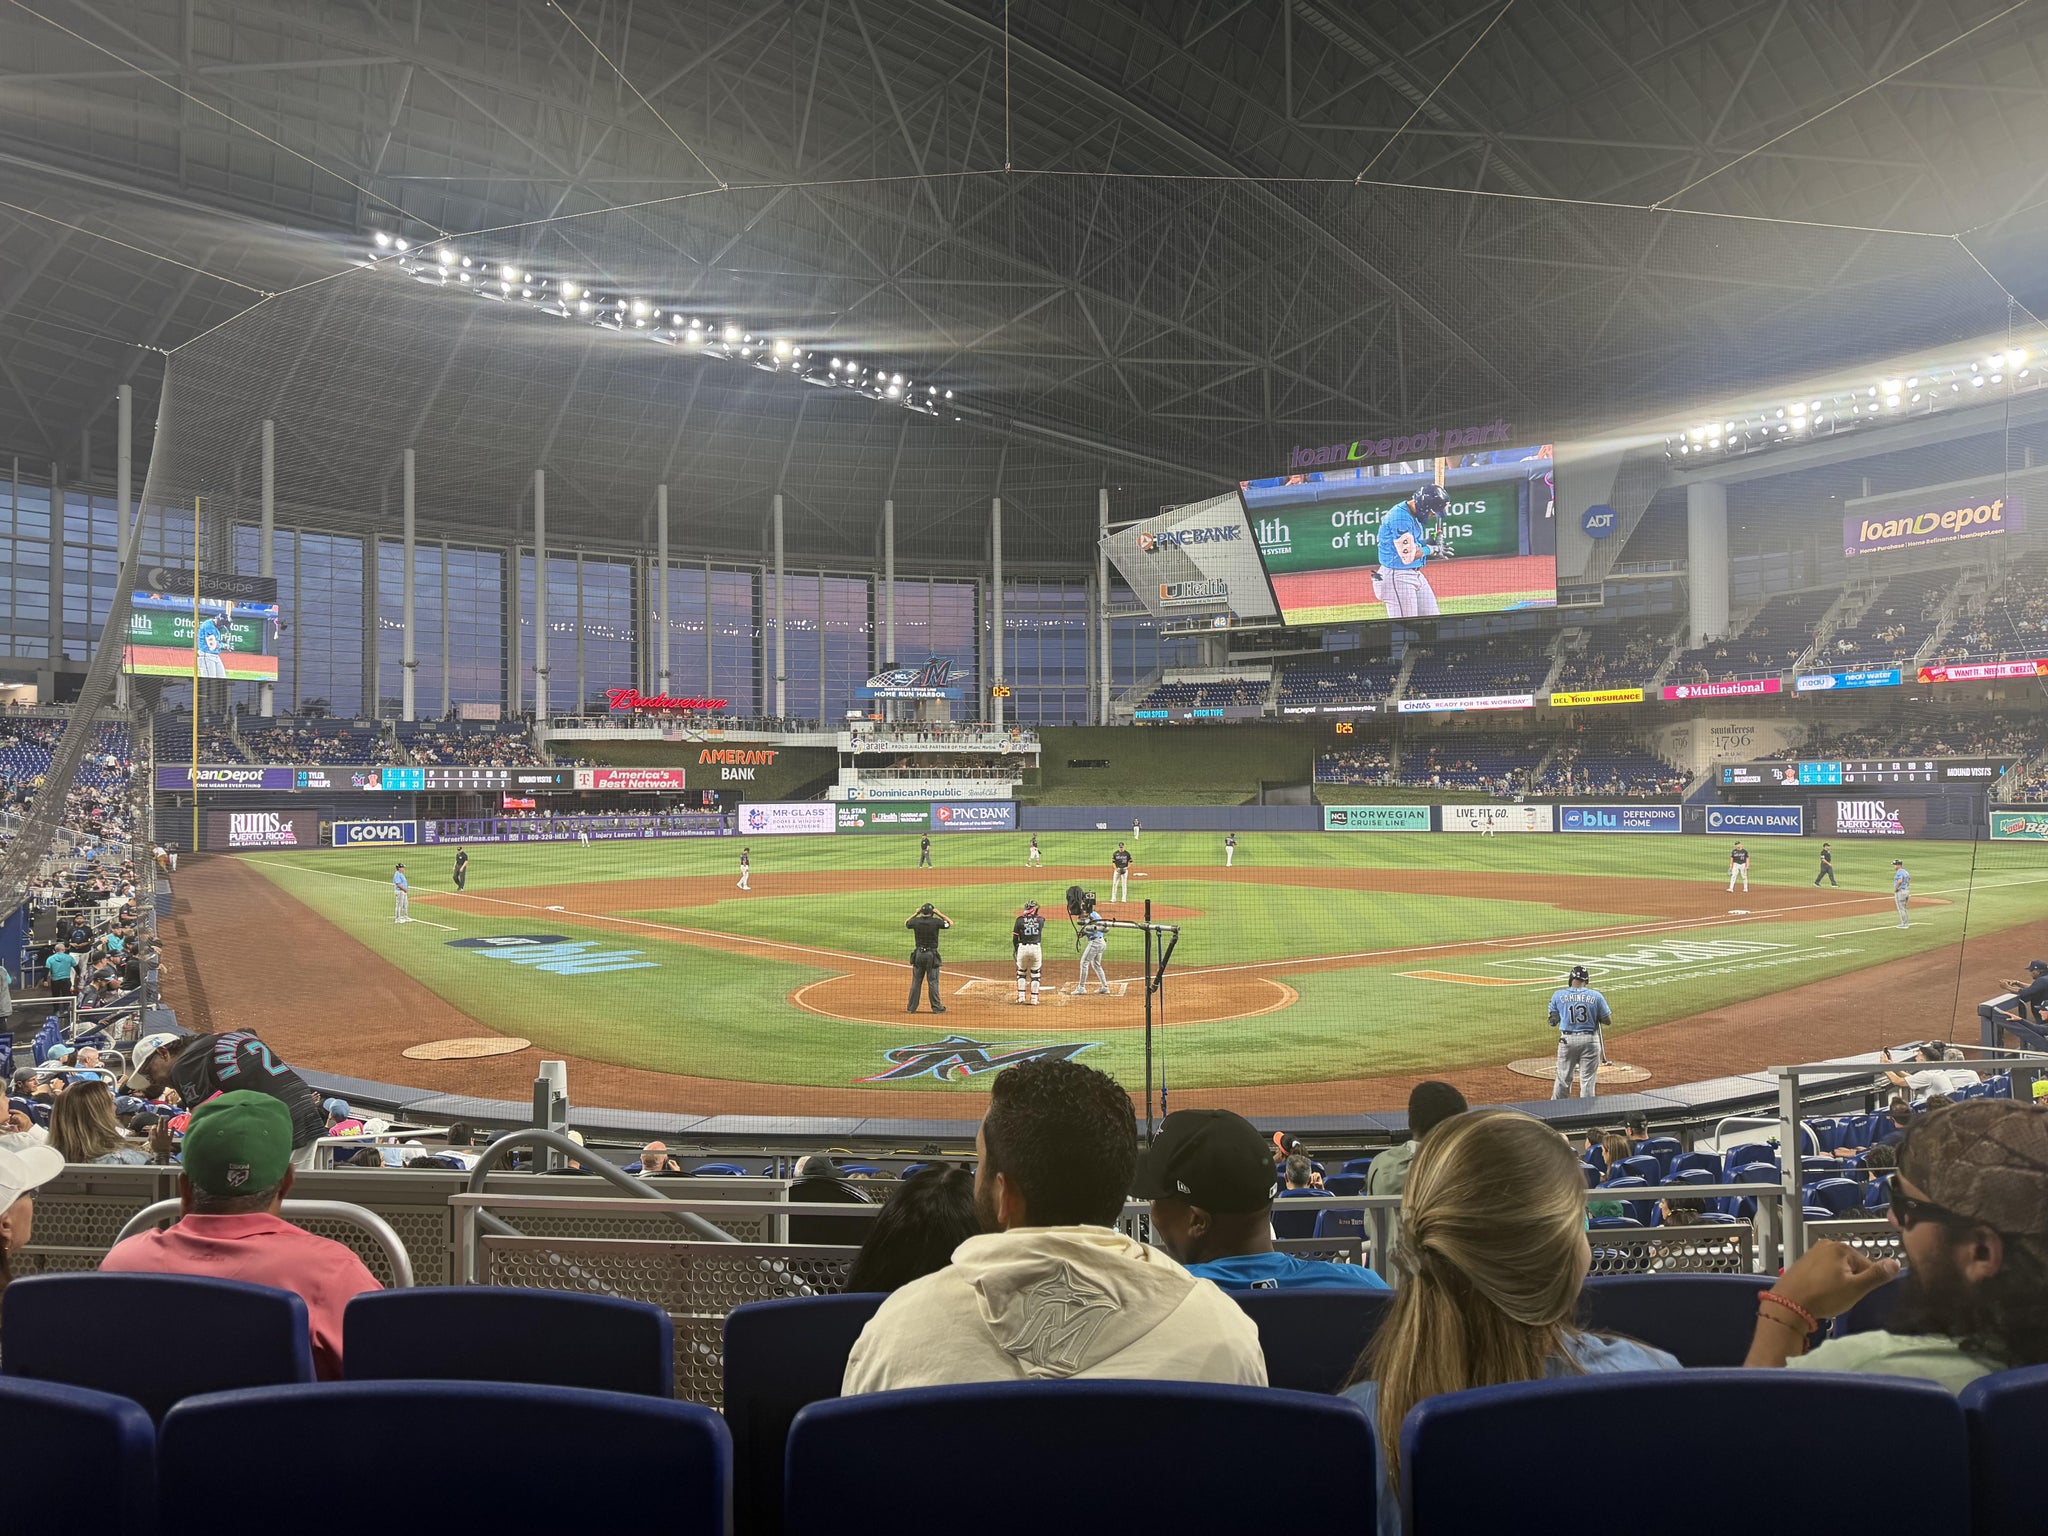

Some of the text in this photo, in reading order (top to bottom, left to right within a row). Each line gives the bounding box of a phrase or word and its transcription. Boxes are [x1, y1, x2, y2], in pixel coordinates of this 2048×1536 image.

[1292, 418, 1512, 468] loanDepot park
[1586, 513, 1614, 529] ADT
[1859, 499, 2004, 542] loanDepot
[1331, 532, 1351, 549] of
[1860, 546, 1876, 554] Home
[1877, 542, 1904, 552] Purchase
[1908, 539, 1926, 547] Home
[1926, 534, 1957, 545] Refinance
[1267, 546, 1292, 555] SYSTEM
[1867, 671, 1892, 679] water
[1954, 669, 1973, 677] WANT
[1690, 681, 1765, 697] Multinational
[605, 688, 729, 710] Budweiser
[1593, 693, 1640, 702] INSURANCE
[1135, 710, 1151, 719] PITCH
[1151, 710, 1169, 718] SPEED
[1193, 709, 1224, 718] PITCH TYPE
[865, 741, 888, 753] arajet
[1011, 742, 1030, 753] arajet
[699, 749, 775, 766] AMERANT
[308, 772, 325, 780] TYLER
[608, 770, 670, 780] America's
[721, 767, 756, 780] BANK
[1947, 768, 1971, 777] MOUND
[1971, 767, 1992, 776] VISITS
[308, 780, 331, 788] PHILLIPS
[598, 779, 679, 789] Best Network
[1331, 811, 1347, 820] NCL
[1351, 810, 1425, 819] NORWEGIAN
[1456, 808, 1478, 818] LIVE.
[1495, 808, 1509, 818] GO.
[1623, 810, 1675, 819] DEFENDING
[1887, 810, 1899, 821] of
[1583, 810, 1617, 827] blu
[1623, 819, 1651, 827] HOME
[1725, 815, 1798, 826] OCEAN BANK
[280, 821, 293, 832] of
[439, 835, 500, 843] WernerHoffman.com
[614, 831, 637, 839] Lawyers
[1560, 994, 1596, 1004] CAMINERO
[1568, 1004, 1588, 1024] 13
[244, 1040, 290, 1076] 2
